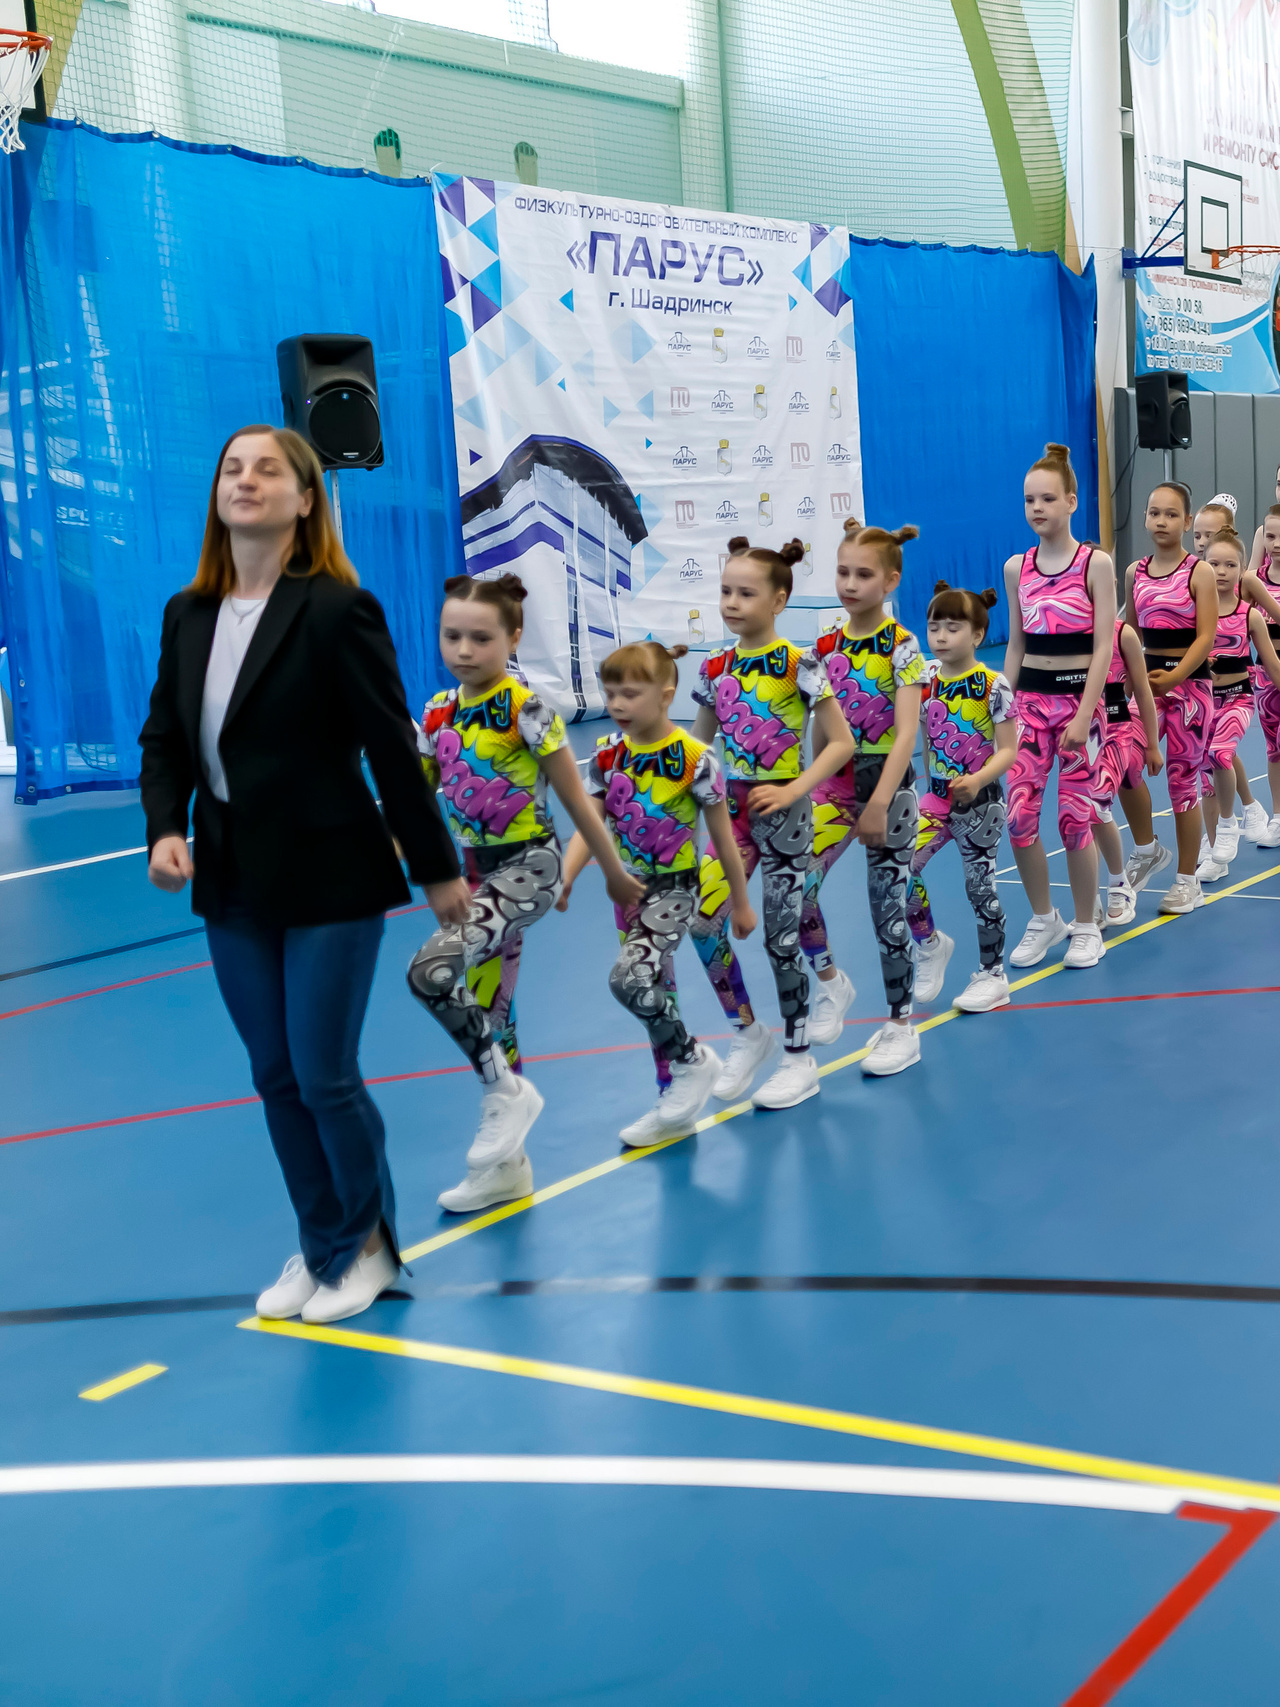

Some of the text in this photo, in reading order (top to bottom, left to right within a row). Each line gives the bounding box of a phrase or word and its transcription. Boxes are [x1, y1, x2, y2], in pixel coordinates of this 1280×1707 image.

[1212, 134, 1257, 164] РЕМОНТУ
[514, 196, 798, 244] ФИЗКУЛЬТУРНО-ОЗДОРОВИТЕЛЬНЫЙ КОМПЛЕКС
[565, 230, 765, 287] «ПАРУС»
[608, 287, 733, 316] г. Шадринск
[667, 343, 692, 352] ПАРУС
[747, 347, 770, 356] ПАРУС
[711, 400, 734, 409] ПАРУС
[788, 402, 810, 410] ПАРУС
[672, 457, 697, 466] ПАРУС
[751, 455, 773, 464] ПАРУС
[715, 511, 739, 520] ПАРУС
[679, 569, 703, 579] ПАРУС
[1056, 673, 1087, 681] DIGITIZ
